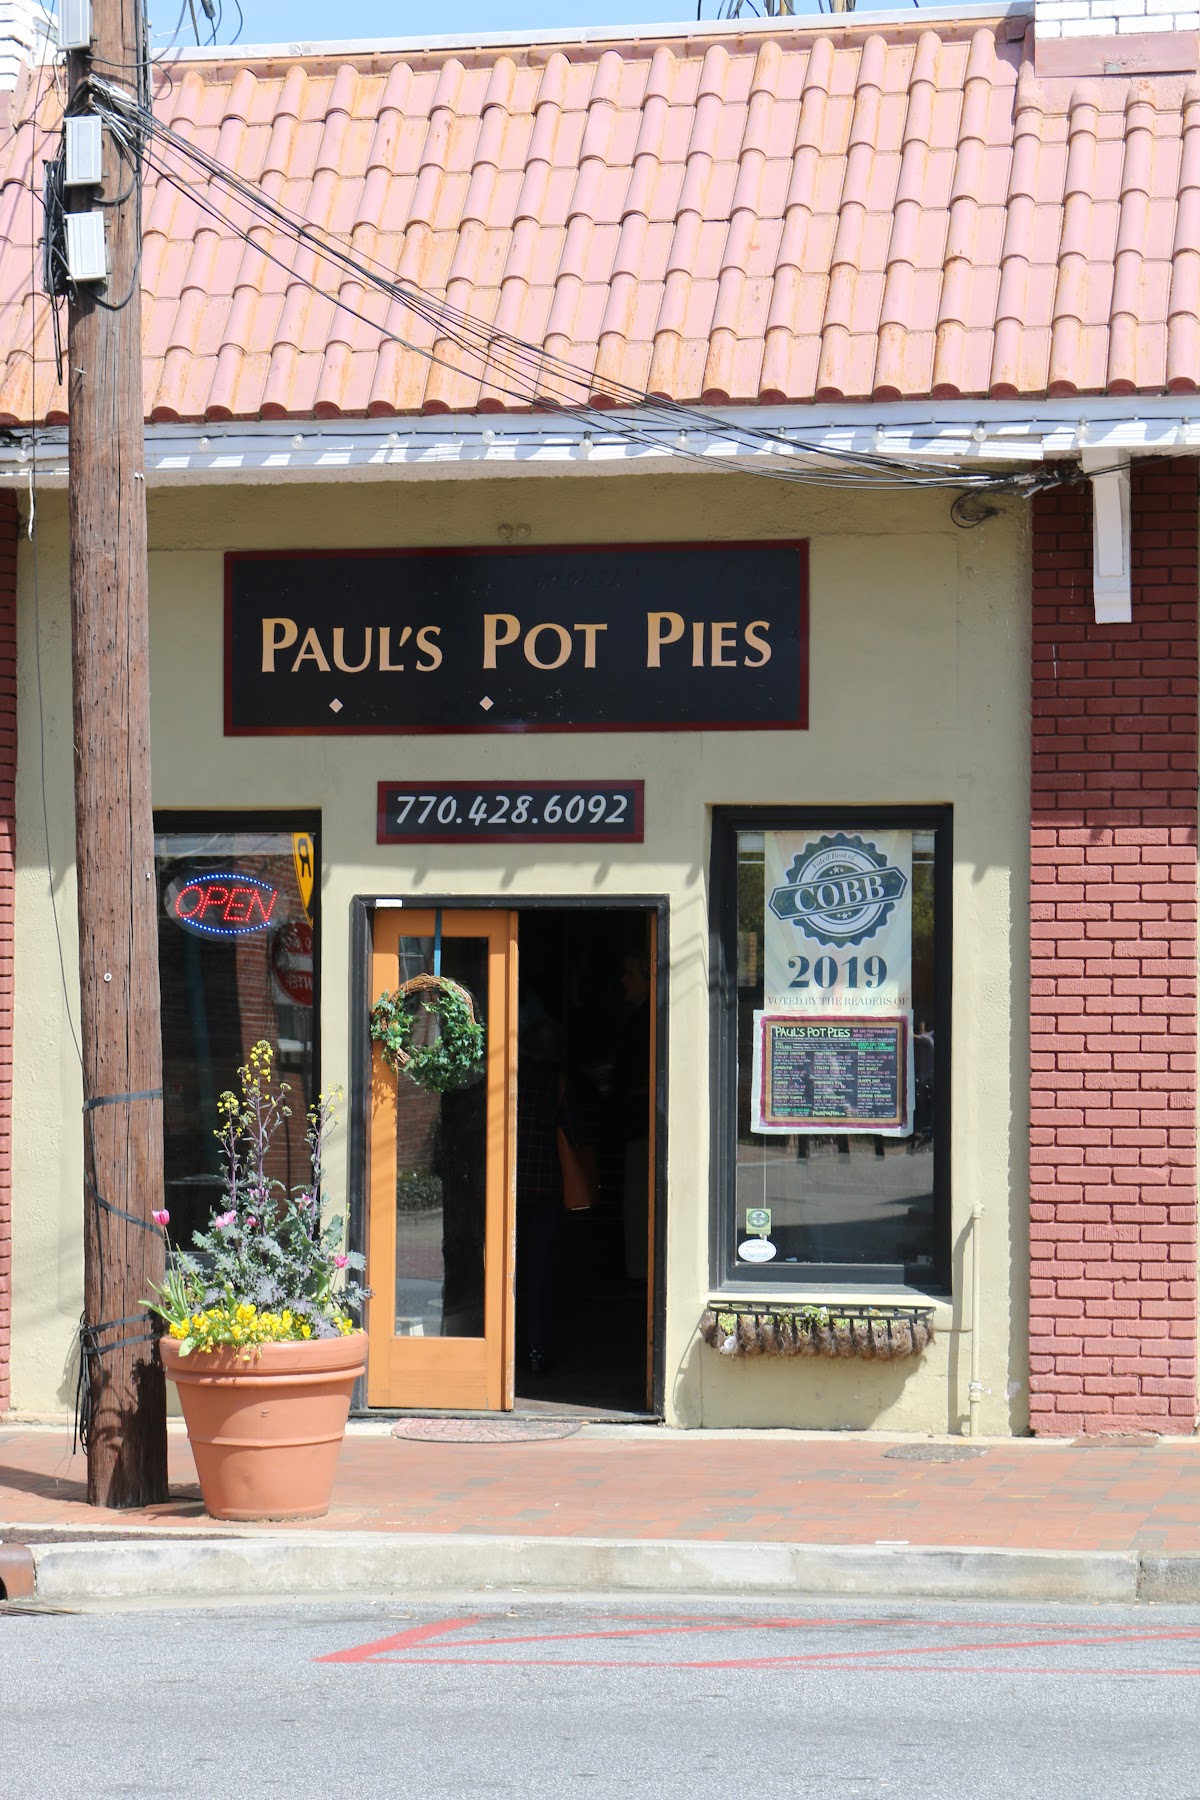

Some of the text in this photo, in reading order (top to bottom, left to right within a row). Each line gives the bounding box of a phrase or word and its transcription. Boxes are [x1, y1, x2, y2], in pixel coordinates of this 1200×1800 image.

[261, 611, 772, 673] PAUL'S POT PIES
[396, 794, 628, 827] 770.428.6092
[811, 851, 858, 869] Voted Best of
[175, 885, 278, 922] OPEN
[794, 875, 885, 912] COBB
[788, 955, 888, 989] 2019
[768, 997, 909, 1006] VOTED BY THE READERS OF
[775, 1027, 806, 1038] PAUL'S
[807, 1027, 826, 1038] POT
[827, 1027, 851, 1038] PIES
